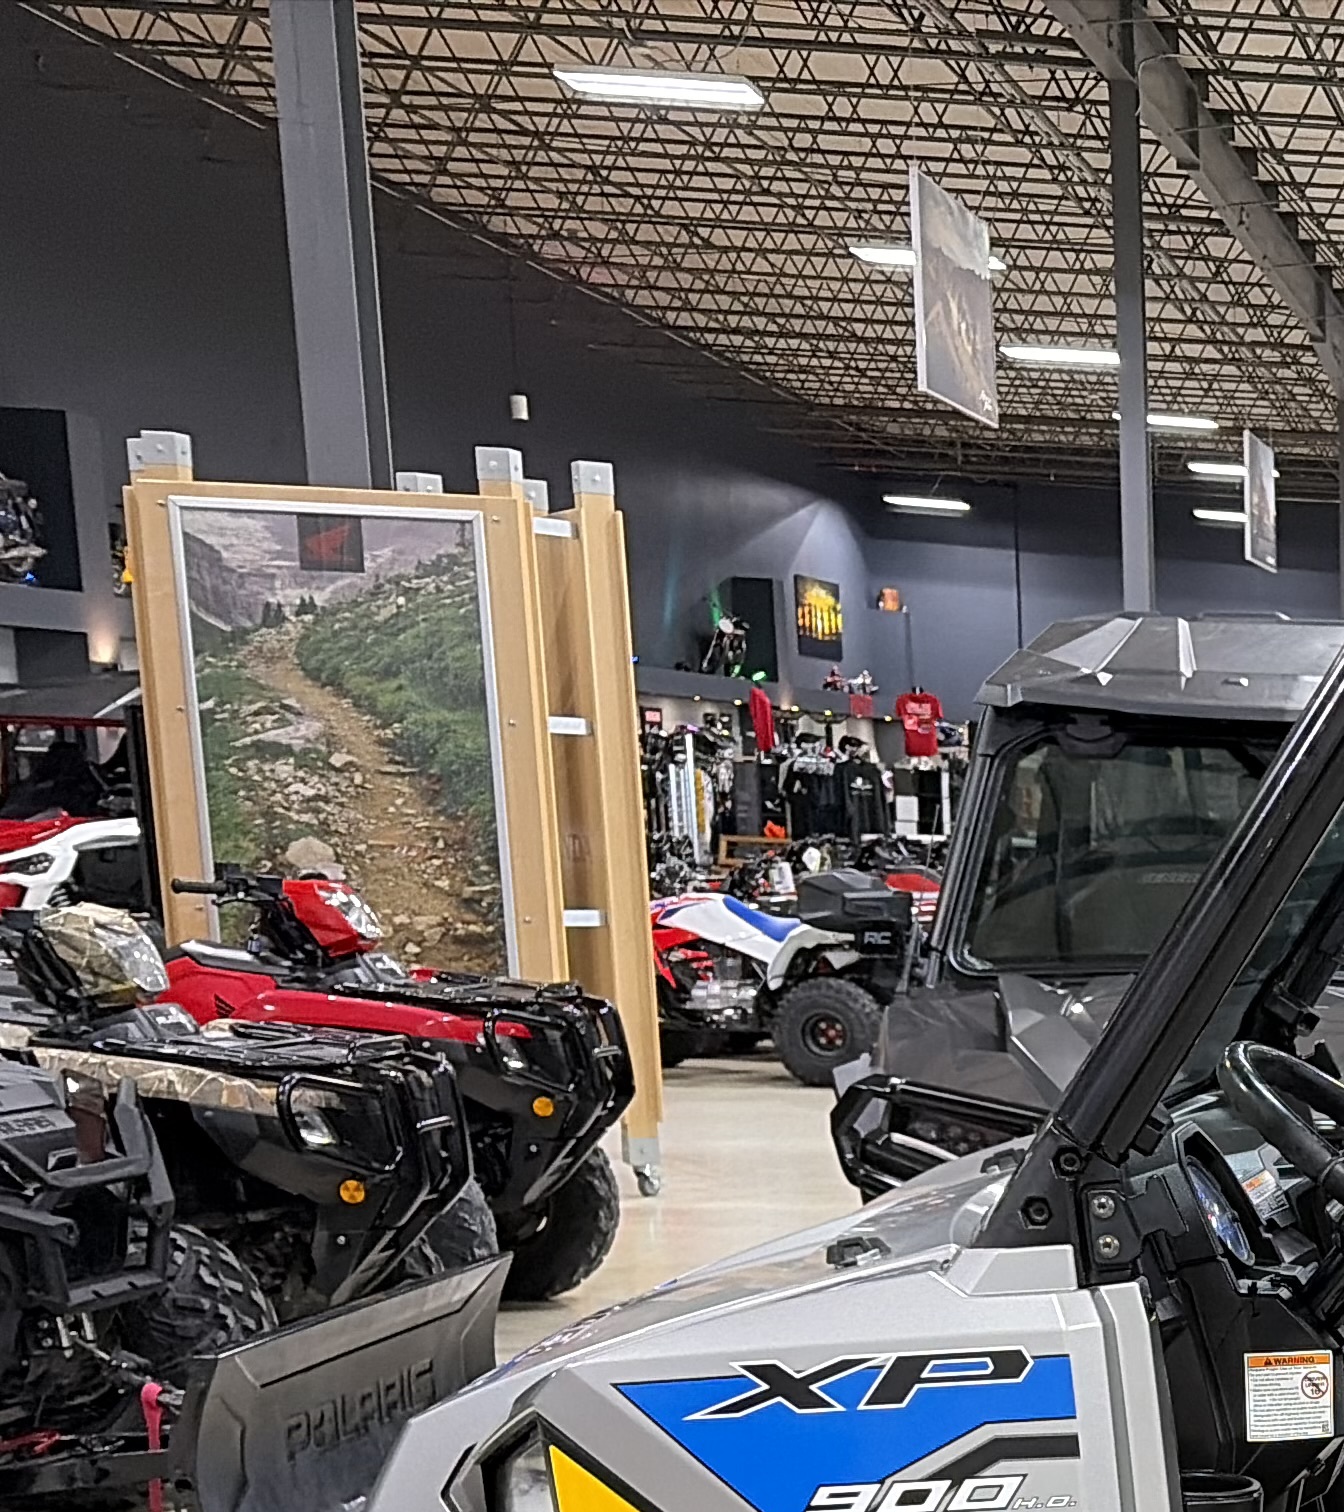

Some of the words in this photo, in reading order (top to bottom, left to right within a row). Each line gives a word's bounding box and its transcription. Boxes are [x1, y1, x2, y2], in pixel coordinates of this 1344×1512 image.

[683, 1345, 1034, 1421] XP
[1273, 1356, 1315, 1365] WARNING
[285, 1358, 437, 1465] POLARIS
[1013, 1495, 1078, 1510] H.O.
